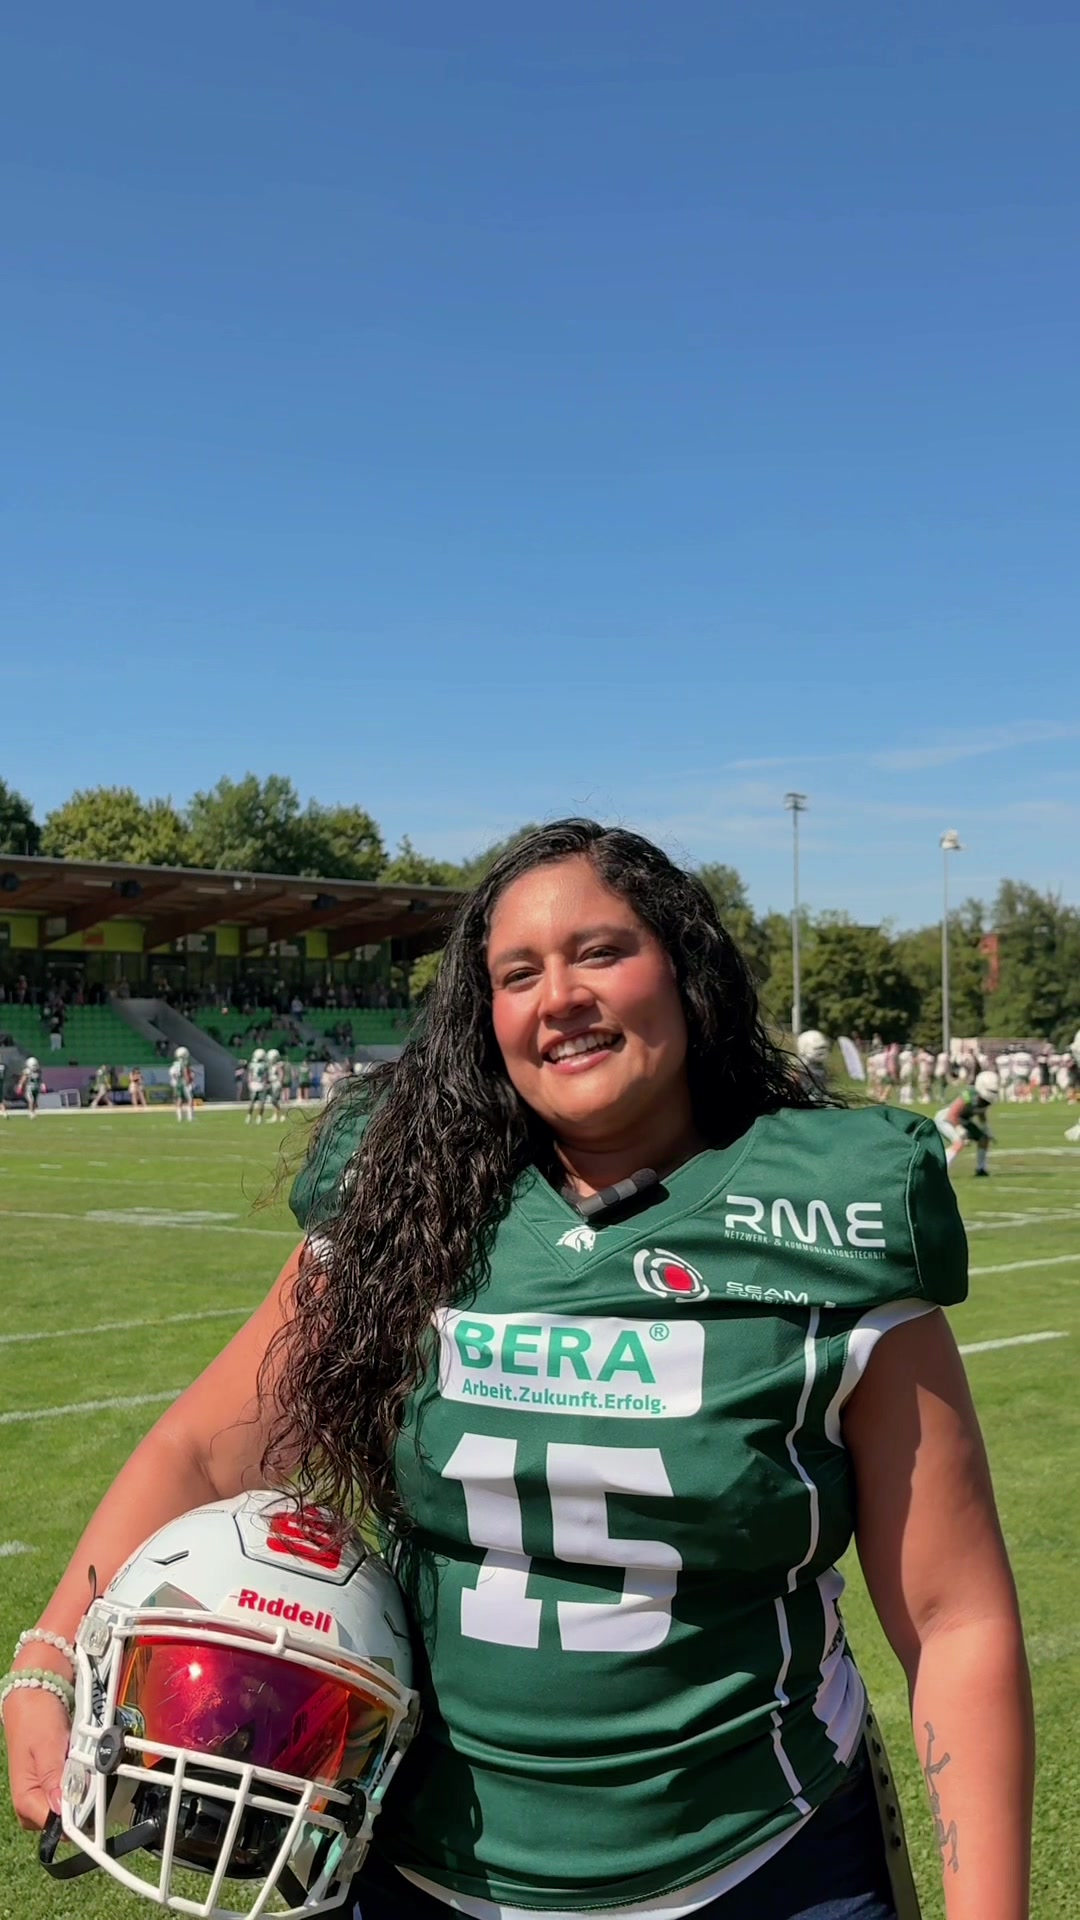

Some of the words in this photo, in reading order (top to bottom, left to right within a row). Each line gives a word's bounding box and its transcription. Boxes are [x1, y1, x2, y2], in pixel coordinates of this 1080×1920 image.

[773, 1238, 782, 1247] &
[726, 1281, 808, 1305] SEAM
[462, 1378, 667, 1414] Arbeit.Zukunft.Erfolg.
[441, 1432, 682, 1652] 15
[238, 1588, 333, 1634] Riddell
